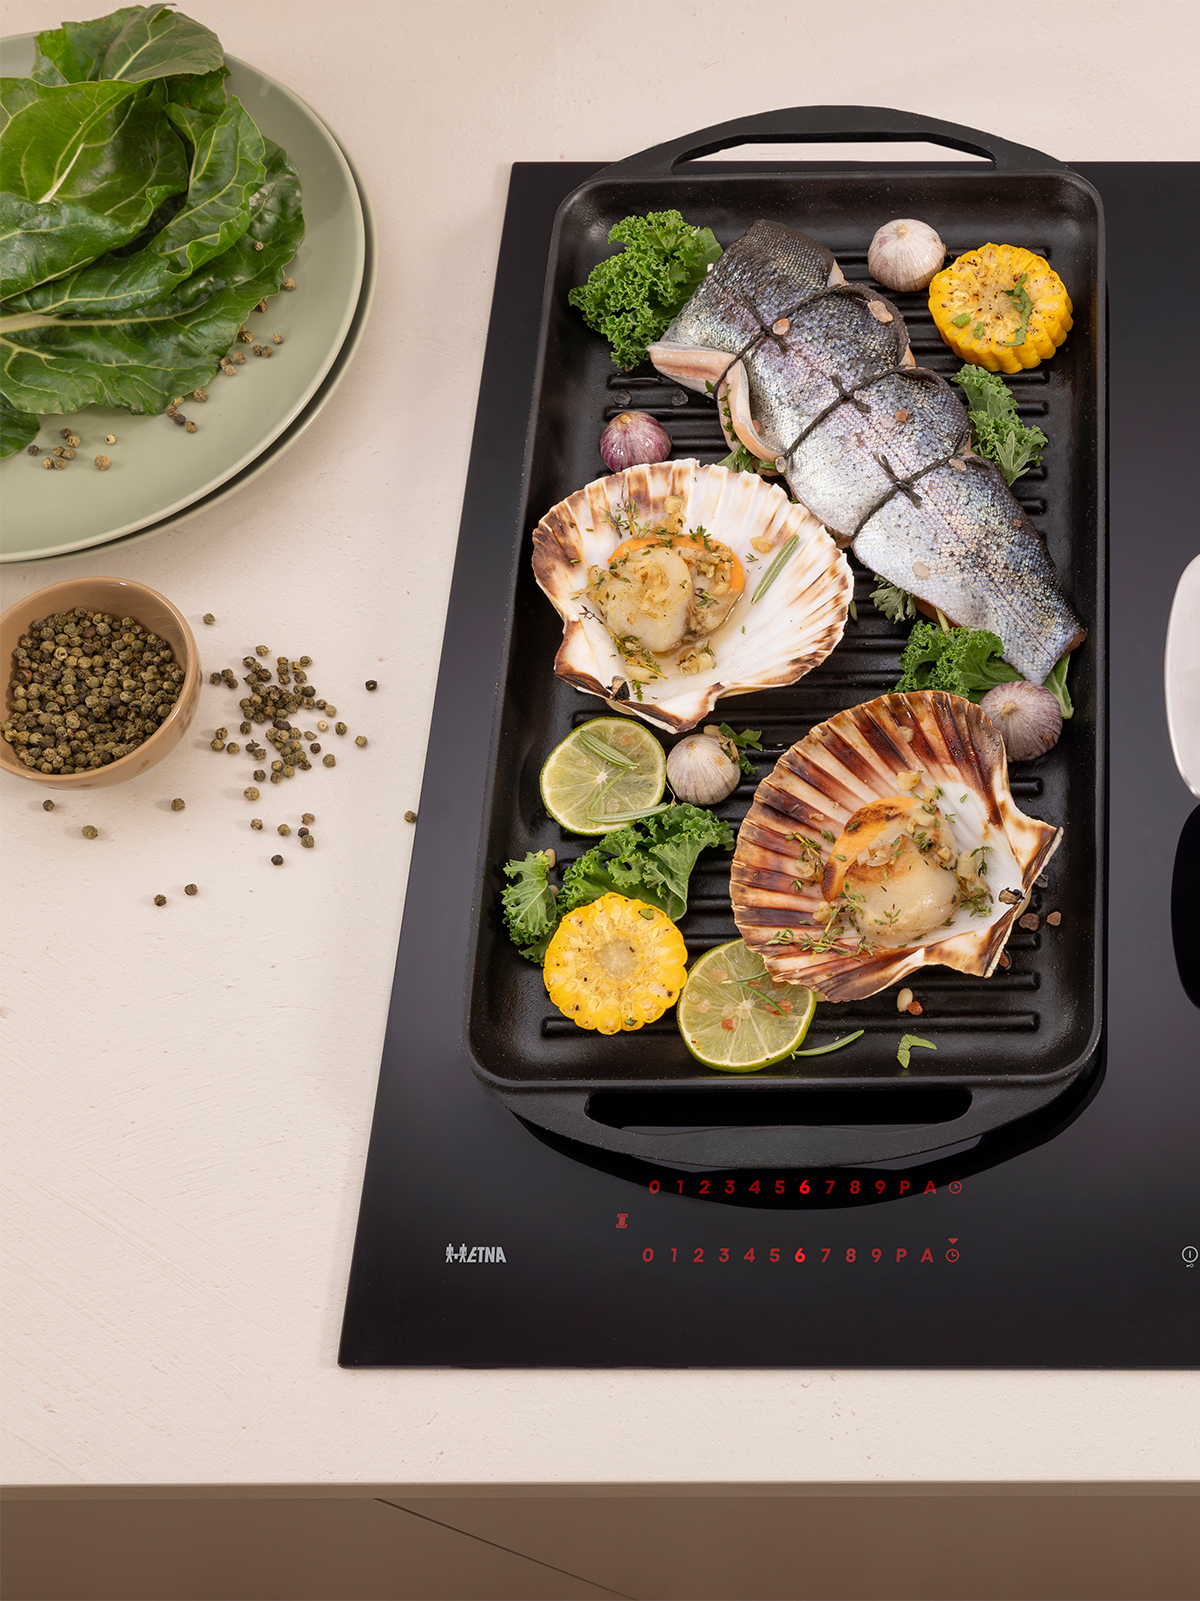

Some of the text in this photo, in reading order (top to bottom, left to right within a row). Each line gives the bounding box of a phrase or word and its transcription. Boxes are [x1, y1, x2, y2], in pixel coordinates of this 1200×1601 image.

[648, 1179, 938, 1195] 0 1 2 3 4 5 6 7 8 9 P A
[466, 1246, 507, 1263] ETNA
[642, 1247, 934, 1263] 0 1 2 3 4 5 6 7 8 9 P A
